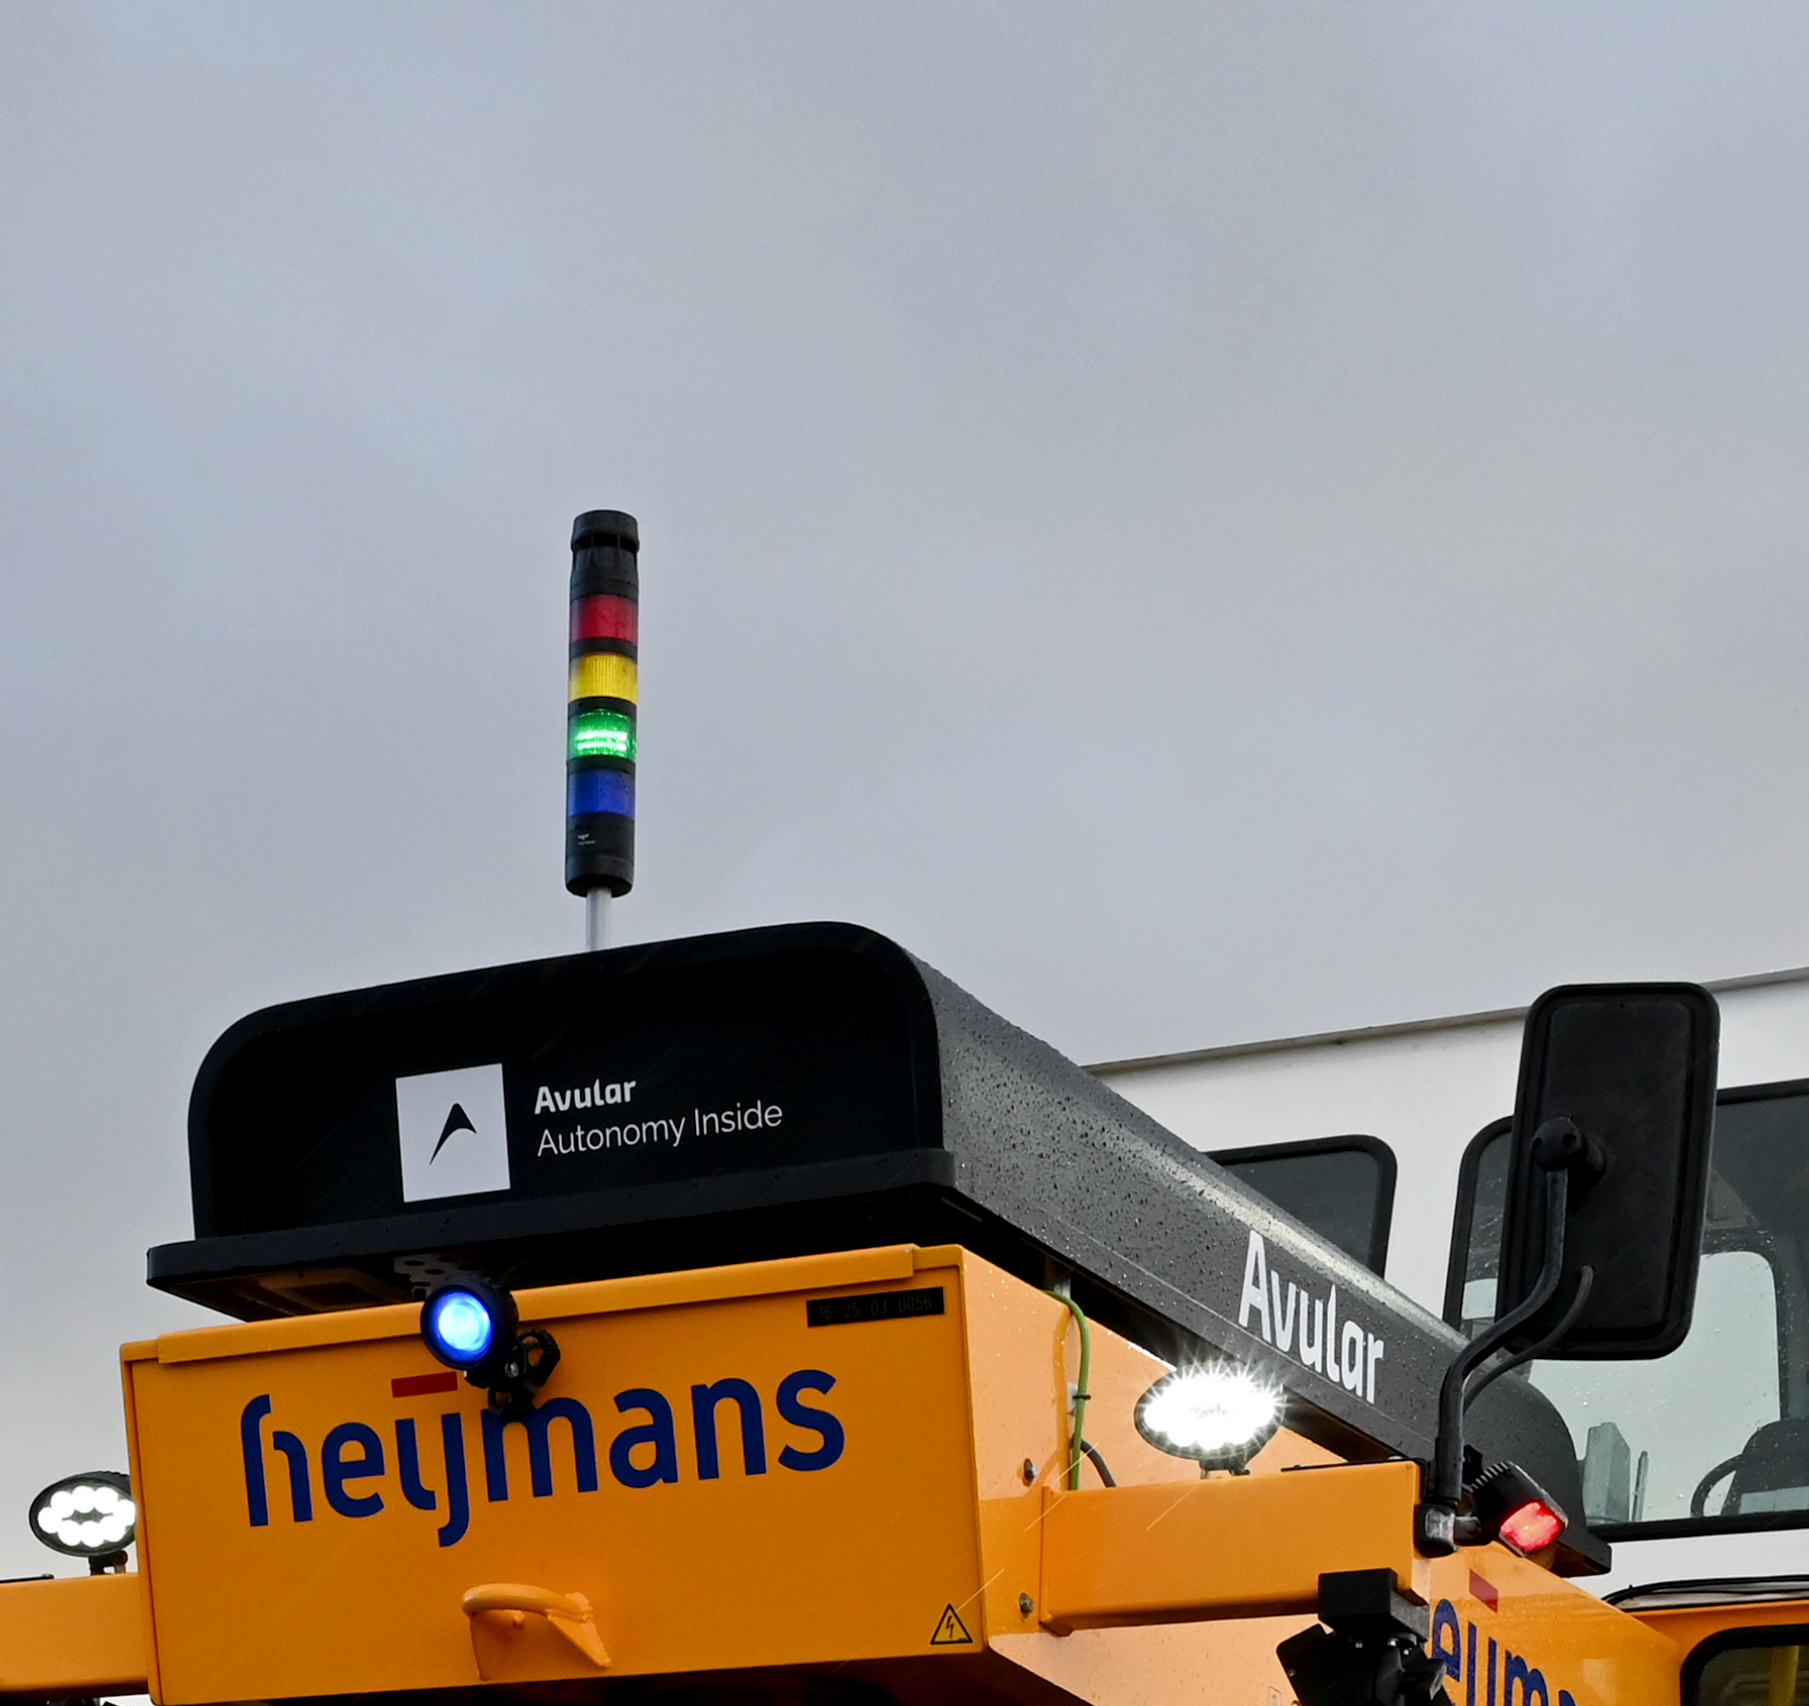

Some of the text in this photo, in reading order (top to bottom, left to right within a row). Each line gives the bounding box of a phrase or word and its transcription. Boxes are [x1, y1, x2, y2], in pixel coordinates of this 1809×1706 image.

[534, 1078, 637, 1115] Avular
[537, 1099, 783, 1157] Autonomy Inside
[1238, 1229, 1385, 1404] Avular
[239, 1368, 846, 1548] heijmans
